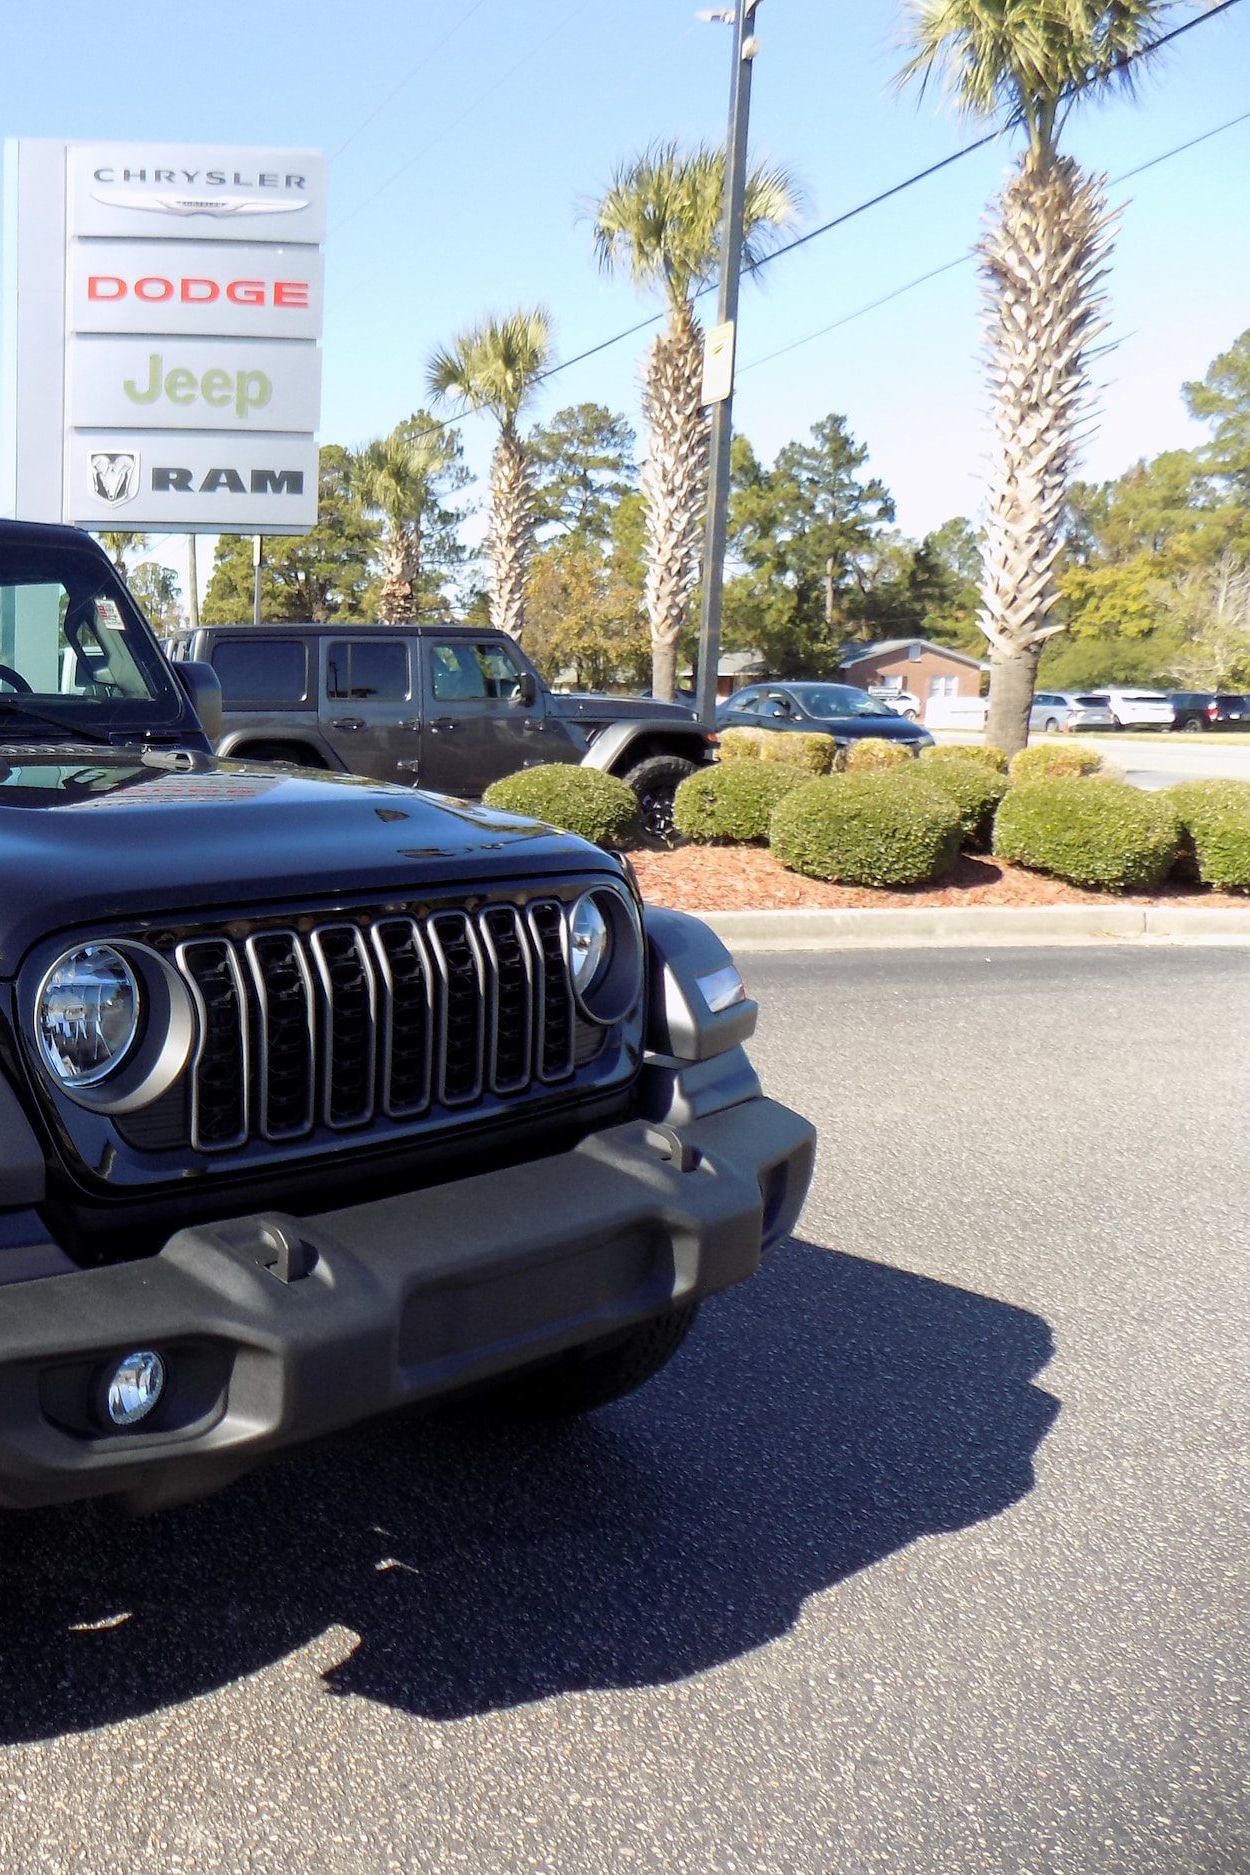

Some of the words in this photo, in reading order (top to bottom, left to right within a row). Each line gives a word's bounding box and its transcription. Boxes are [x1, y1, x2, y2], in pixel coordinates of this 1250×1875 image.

[93, 168, 306, 190] CHRYSLER
[87, 276, 310, 308] DODGE
[123, 353, 272, 418] Jeep
[151, 467, 304, 495] RAM
